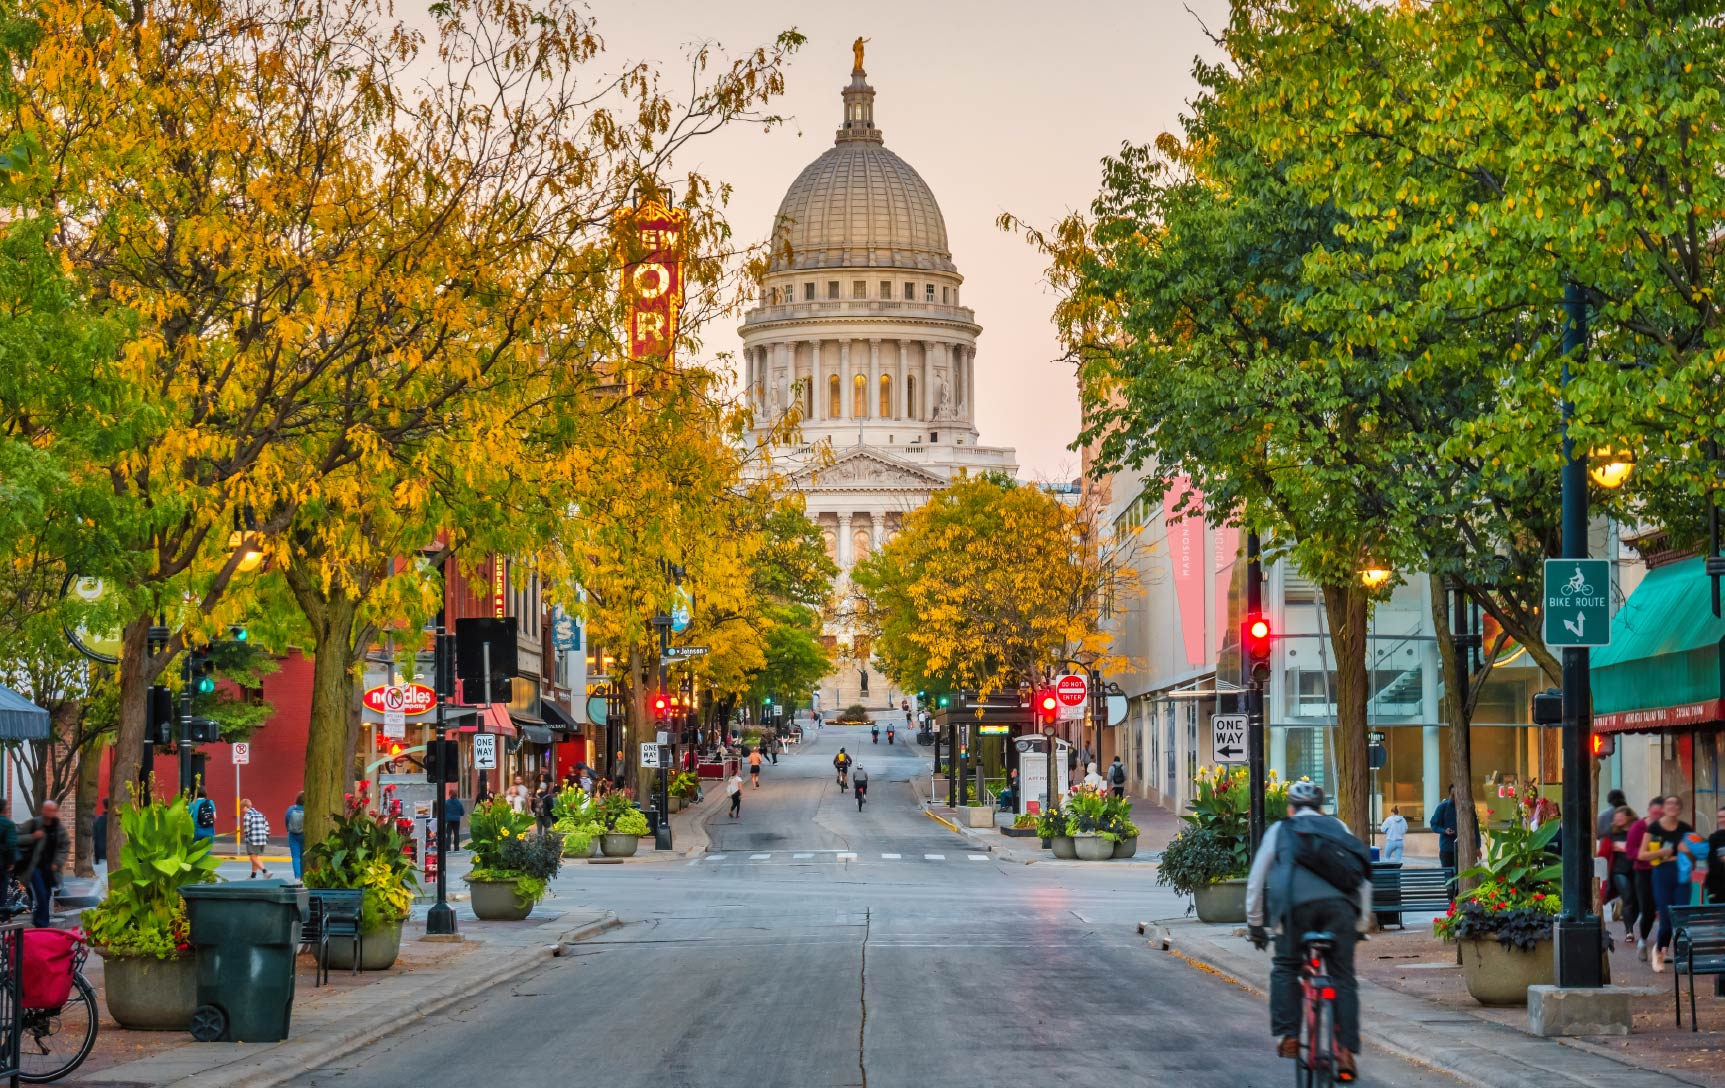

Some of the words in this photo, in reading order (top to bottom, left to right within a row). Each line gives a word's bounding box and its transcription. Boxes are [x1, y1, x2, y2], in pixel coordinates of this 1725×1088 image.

[634, 229, 680, 250] EW
[1182, 529, 1190, 576] MADISON
[1550, 597, 1571, 607] BIKE
[1575, 597, 1606, 607] ROUTE
[680, 647, 704, 655] Johnson
[372, 686, 431, 704] ndles
[1216, 720, 1244, 730] ONE
[476, 738, 493, 747] ONE
[1216, 732, 1244, 744] WAY
[476, 747, 493, 757] WAY
[643, 744, 657, 752] ONE
